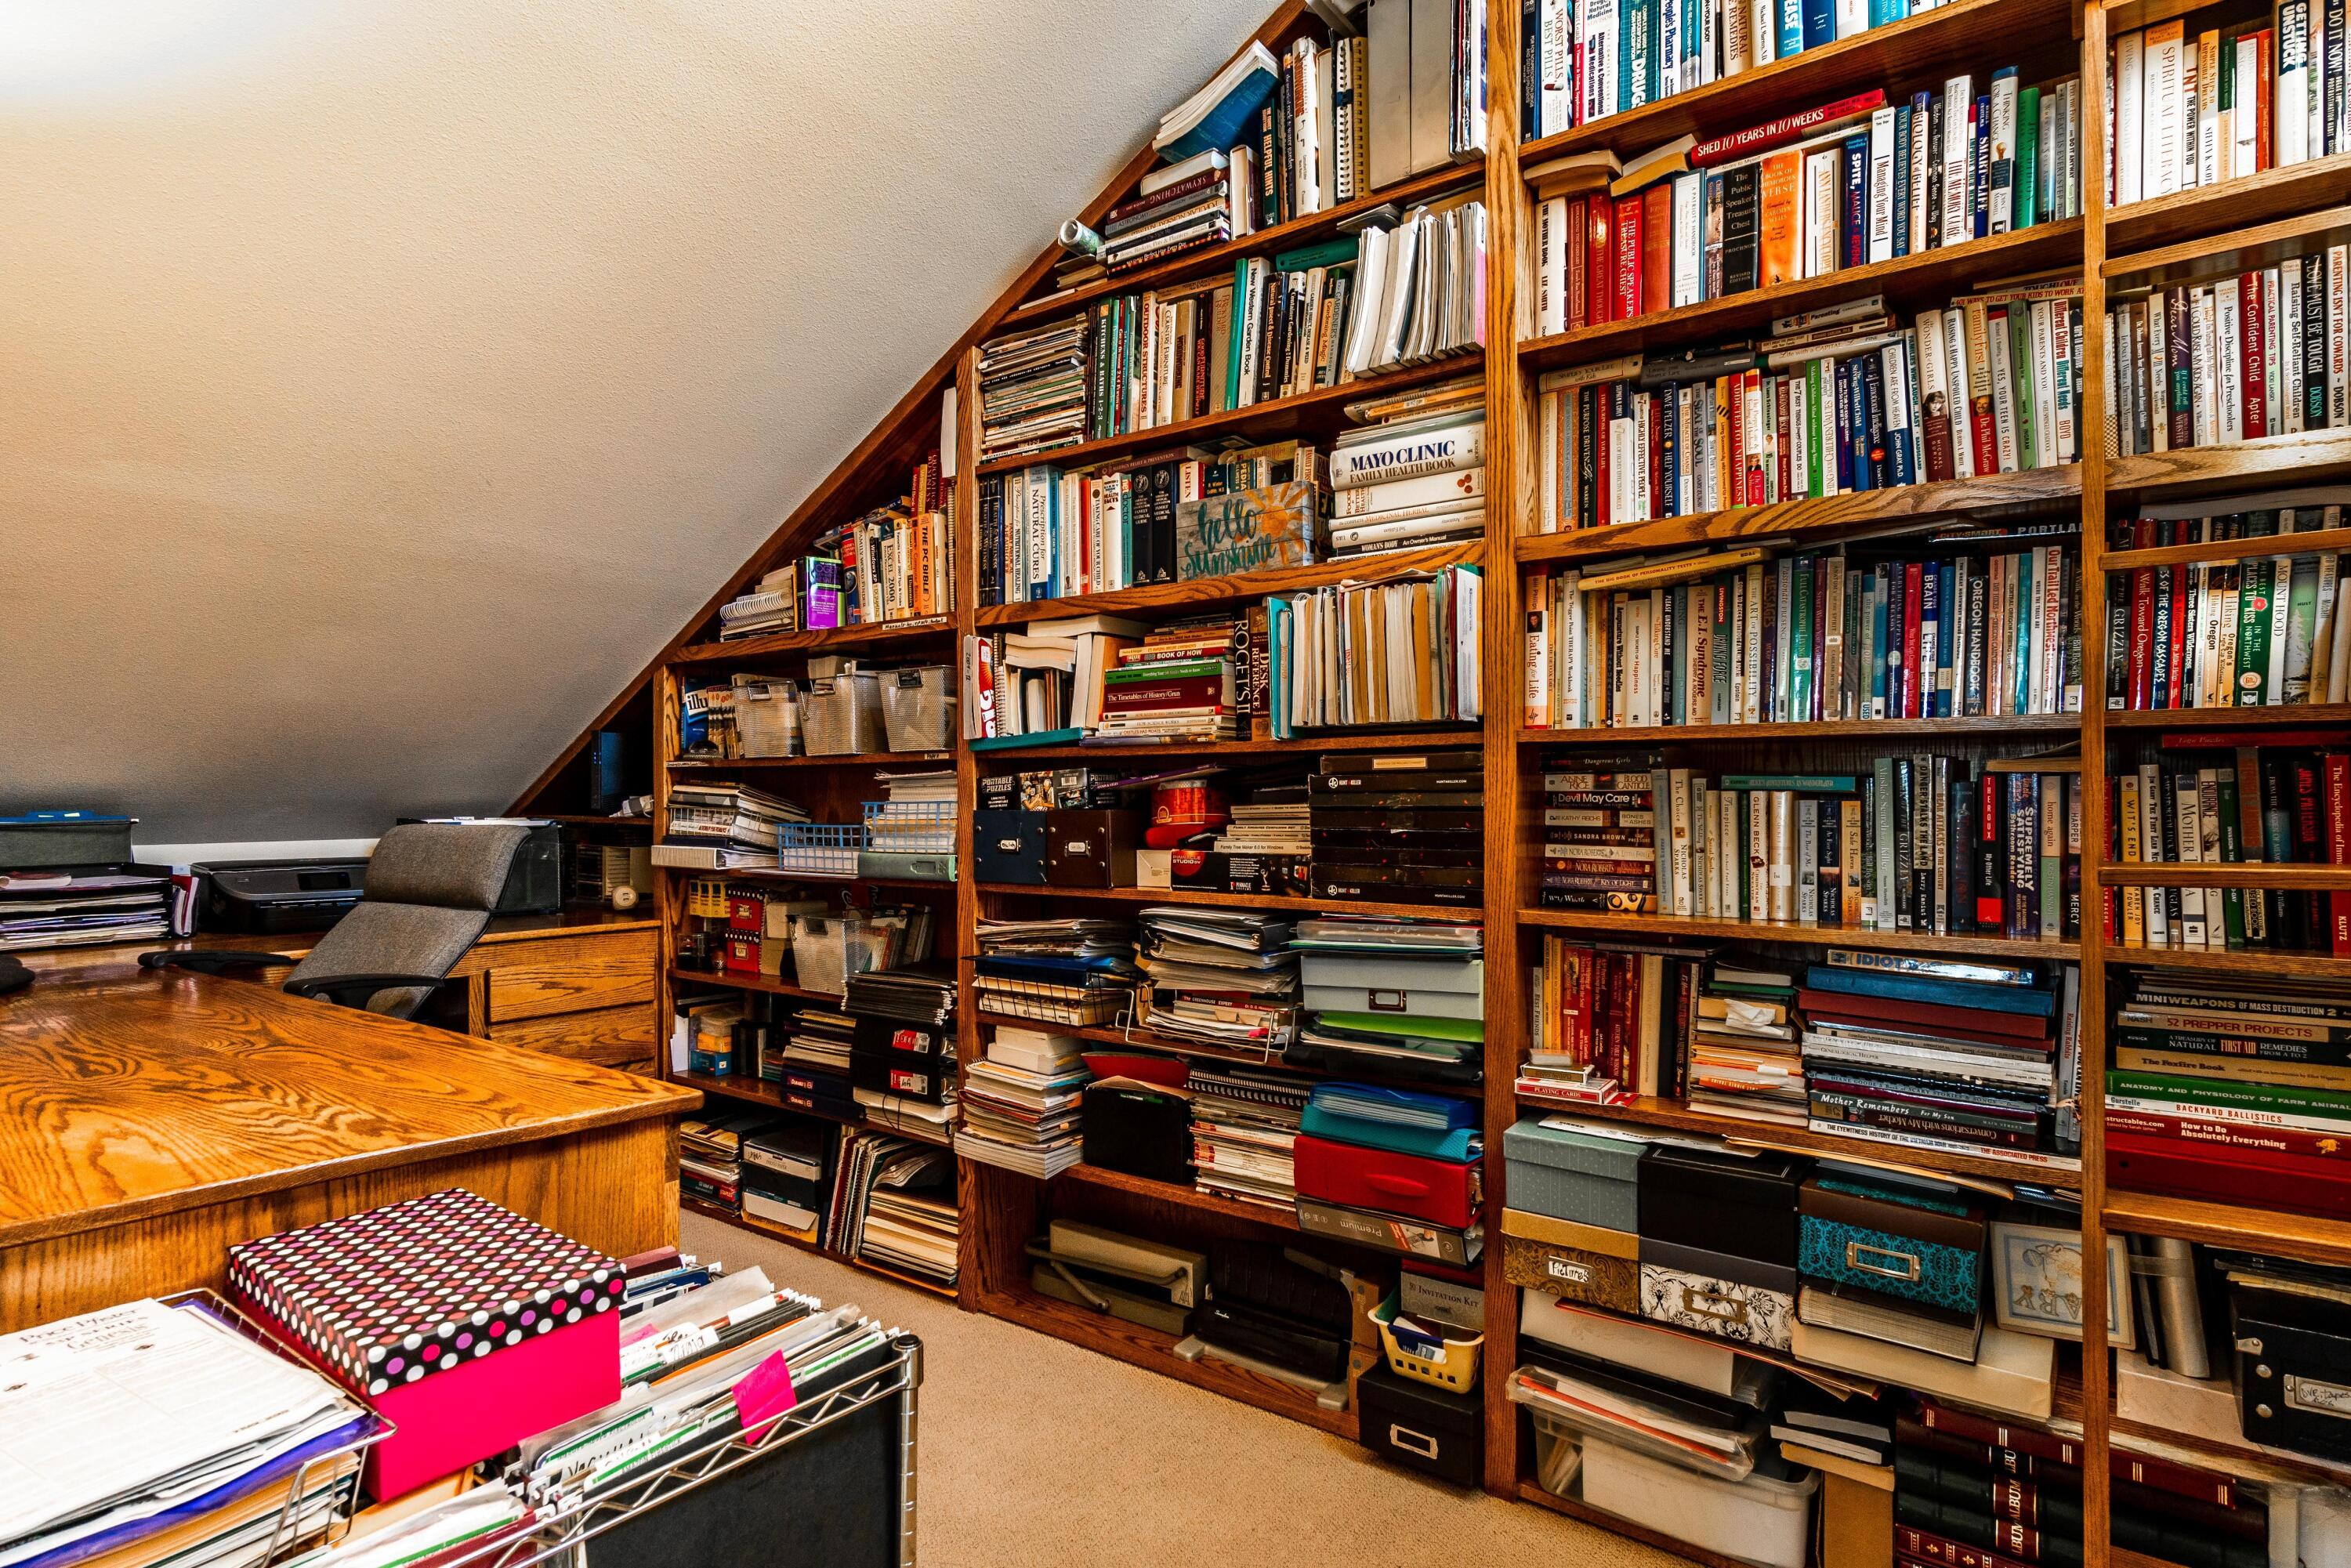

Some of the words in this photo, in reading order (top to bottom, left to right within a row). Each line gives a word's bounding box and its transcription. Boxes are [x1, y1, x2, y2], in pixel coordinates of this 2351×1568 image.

[1740, 5, 1748, 56] NATURAL
[2329, 8, 2343, 27] DO
[1730, 7, 1738, 60] REMEDIES
[2282, 5, 2295, 71] UNSTUCK
[2296, 2, 2307, 63] GETTING
[2329, 28, 2343, 40] IT
[2328, 42, 2343, 74] NOW!
[1697, 143, 1721, 157] SHED
[1722, 136, 1734, 150] 10
[1737, 126, 1765, 144] YEARS
[1766, 121, 1777, 136] IN
[1777, 117, 1790, 135] 10
[1791, 108, 1824, 129] WEEKS
[1263, 134, 1272, 168] HELPFUL
[1150, 176, 1206, 203] SKYWATCHING
[1731, 185, 1751, 194] Public
[1735, 172, 1748, 181] The
[1874, 161, 1889, 197] Managing
[1726, 194, 1757, 208] Speaker's
[1726, 207, 1755, 219] Treasure
[1875, 197, 1889, 216] Your
[1731, 220, 1750, 230] Chest
[1875, 218, 1888, 236] Mind
[2333, 251, 2342, 295] PARENTING
[1248, 288, 1257, 320] Western
[2247, 283, 2259, 301] The
[2291, 282, 2300, 319] Raising
[1246, 323, 1255, 353] Garden
[2248, 303, 2259, 359] Confident
[2333, 317, 2342, 332] FOR
[2291, 320, 2302, 377] Self-Reliant
[2333, 333, 2343, 374] COWARDS
[2248, 361, 2260, 382] Child
[2250, 397, 2260, 425] Apter
[2333, 386, 2344, 418] DOBSON
[2059, 419, 2070, 439] BOYD
[1350, 451, 1393, 472] MAYO
[1396, 440, 1455, 463] CLINIC
[2001, 435, 2010, 460] CRAZY!
[1349, 471, 1384, 483] FAMILY
[1386, 464, 1425, 477] HEALTH
[1425, 458, 1455, 471] BOOK
[1031, 490, 1040, 541] NATURAL
[1197, 498, 1256, 554] hello
[922, 549, 929, 563] PC
[1182, 534, 1277, 580] Sunshine
[2049, 549, 2060, 567] Our
[1639, 566, 1675, 577] PERSONALITY
[2048, 568, 2059, 587] Trail
[2139, 573, 2150, 595] Walk
[2275, 564, 2288, 599] MOUNT
[2047, 588, 2059, 603] Led
[2159, 581, 2169, 590] OF
[2159, 592, 2168, 606] THE
[1972, 580, 1983, 621] OREGON
[2139, 597, 2150, 632] Toward
[2157, 607, 2168, 638] OREGON
[2274, 601, 2285, 637] HOOD
[2045, 604, 2059, 659] Northwest
[1234, 620, 1250, 701] ROGET'S
[1528, 634, 1539, 668] Eating
[1969, 623, 1982, 693] HANDBOOK
[2133, 632, 2147, 668] Oregon
[2154, 639, 2166, 683] CASCADES
[1259, 653, 1269, 689] DESK
[1118, 693, 1141, 701] Timetables
[1236, 703, 1250, 714] II
[1560, 774, 1588, 783] ANNE
[1569, 780, 1589, 790] RICE
[1558, 794, 1581, 803] Devil
[1582, 794, 1604, 805] May
[1605, 794, 1629, 802] Care
[2016, 808, 2025, 889] SATISFYING
[2025, 807, 2034, 891] SUPREMELY
[2128, 837, 2136, 856] END
[2070, 895, 2079, 925] MERCY
[2135, 994, 2236, 1009] MINIWEAPONS
[2249, 1002, 2271, 1012] MASS
[2273, 1005, 2324, 1016] DESTRUCTION
[2183, 1019, 2241, 1032] PREPPER
[2244, 1024, 2313, 1037] PROJECTS
[1534, 1087, 1559, 1096] PLAYING
[1820, 1094, 1853, 1106] Mother
[1857, 1099, 1909, 1115] Remembers
[2176, 1104, 2222, 1117] BACKYARD
[2228, 1110, 2282, 1123] BALLISTICS
[2181, 1122, 2201, 1131] How
[2181, 1130, 2230, 1143] Absolutely
[2233, 1135, 2286, 1150] Everything
[1340, 1221, 1382, 1237] Premium
[2009, 1479, 2021, 1519] ALBUM
